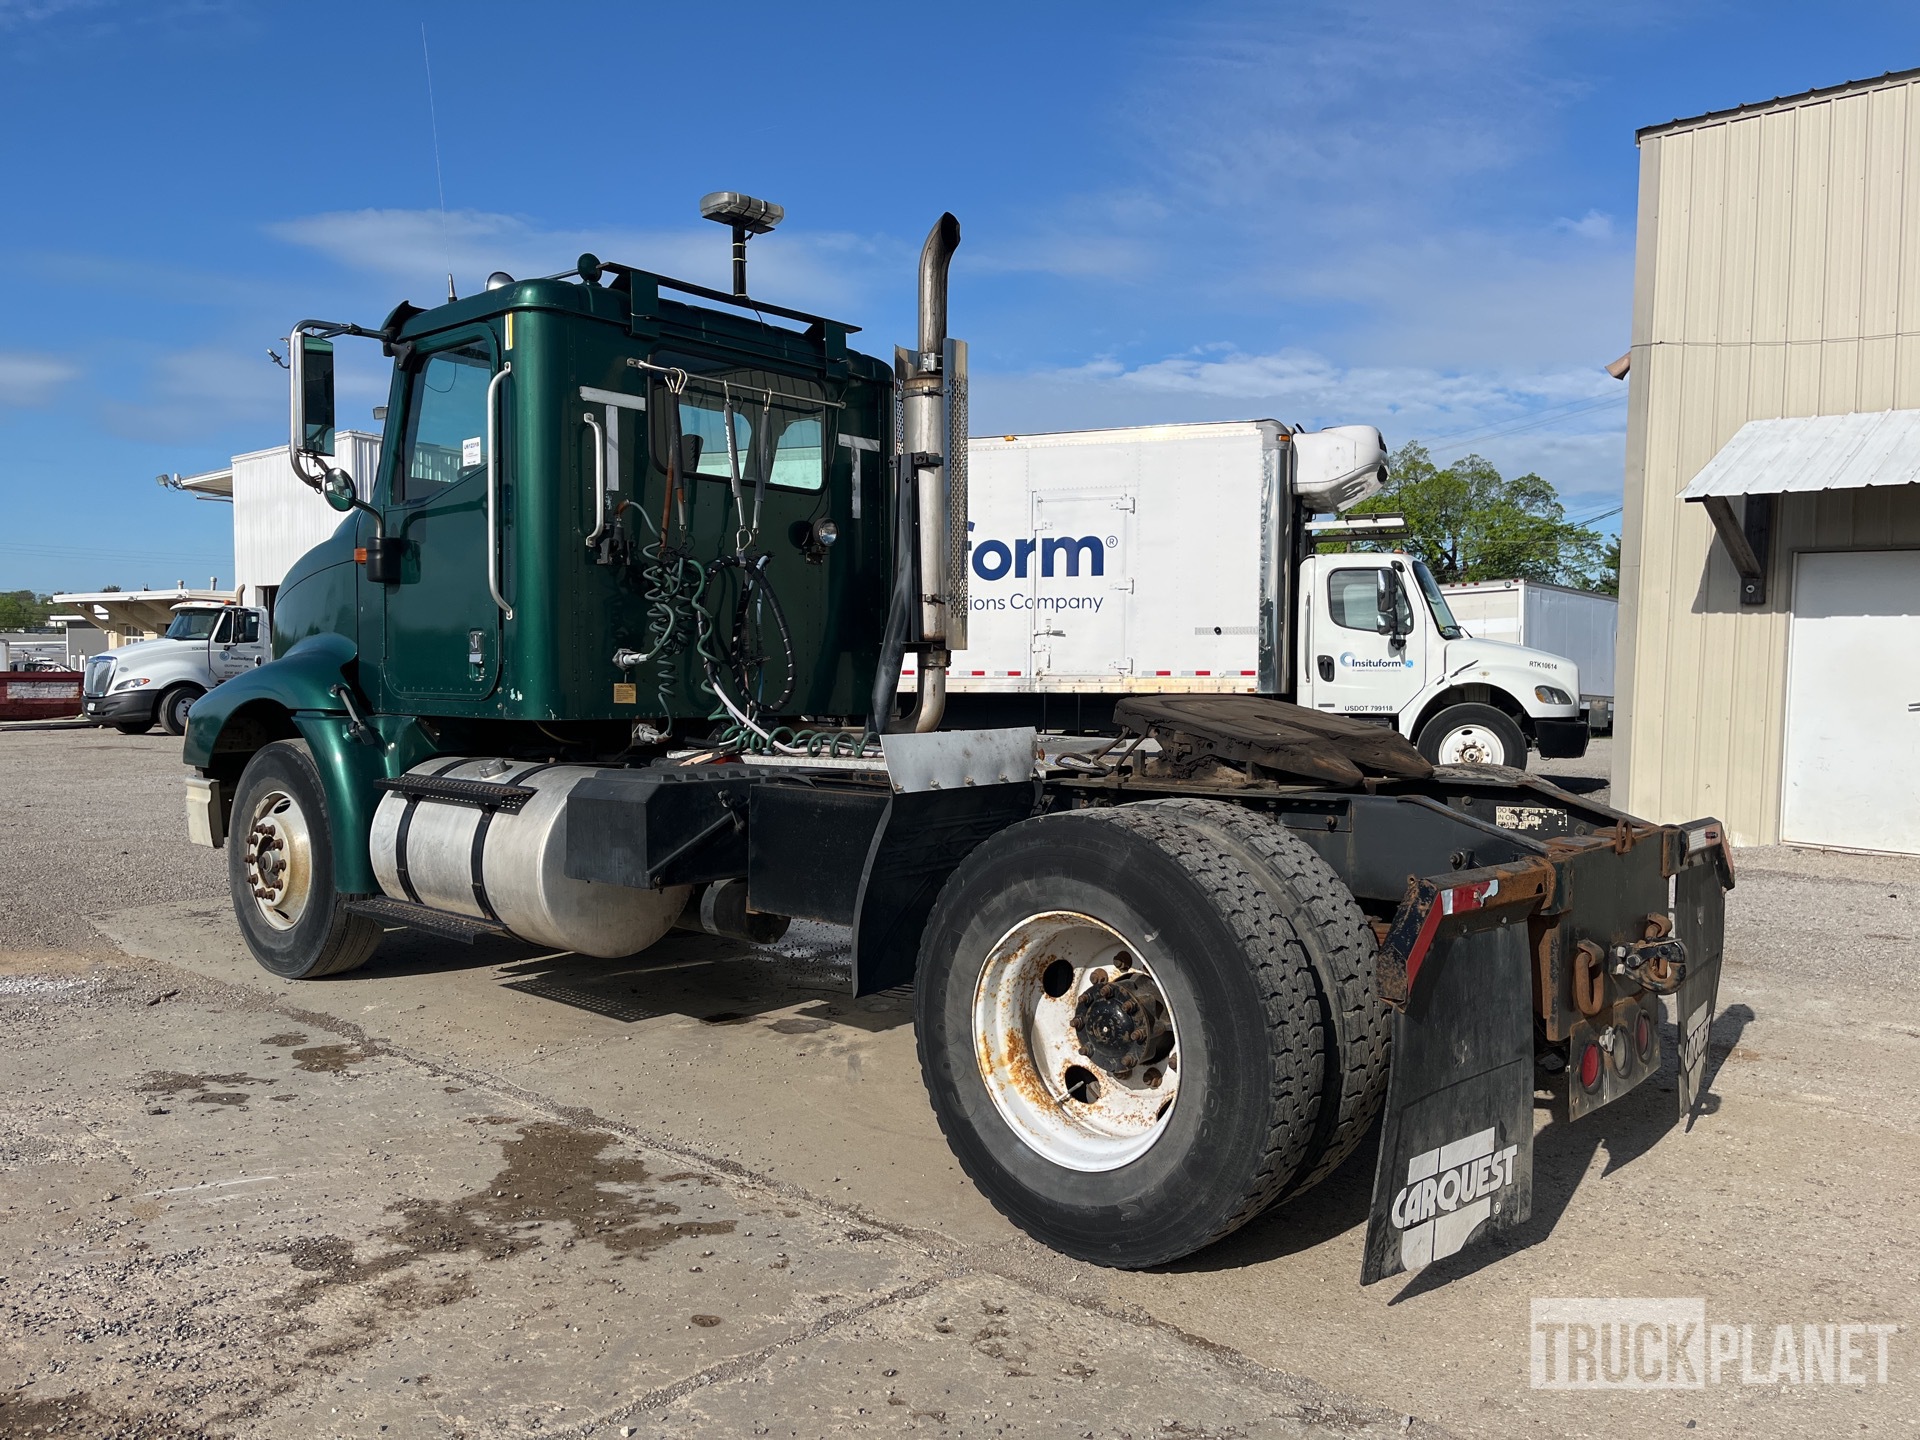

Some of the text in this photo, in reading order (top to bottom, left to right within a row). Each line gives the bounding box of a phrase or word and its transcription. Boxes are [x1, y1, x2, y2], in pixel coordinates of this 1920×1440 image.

[968, 520, 1104, 581] orm
[1010, 593, 1104, 613] Company
[1352, 658, 1401, 668] Insituform
[1391, 1144, 1518, 1229] CARQUEST
